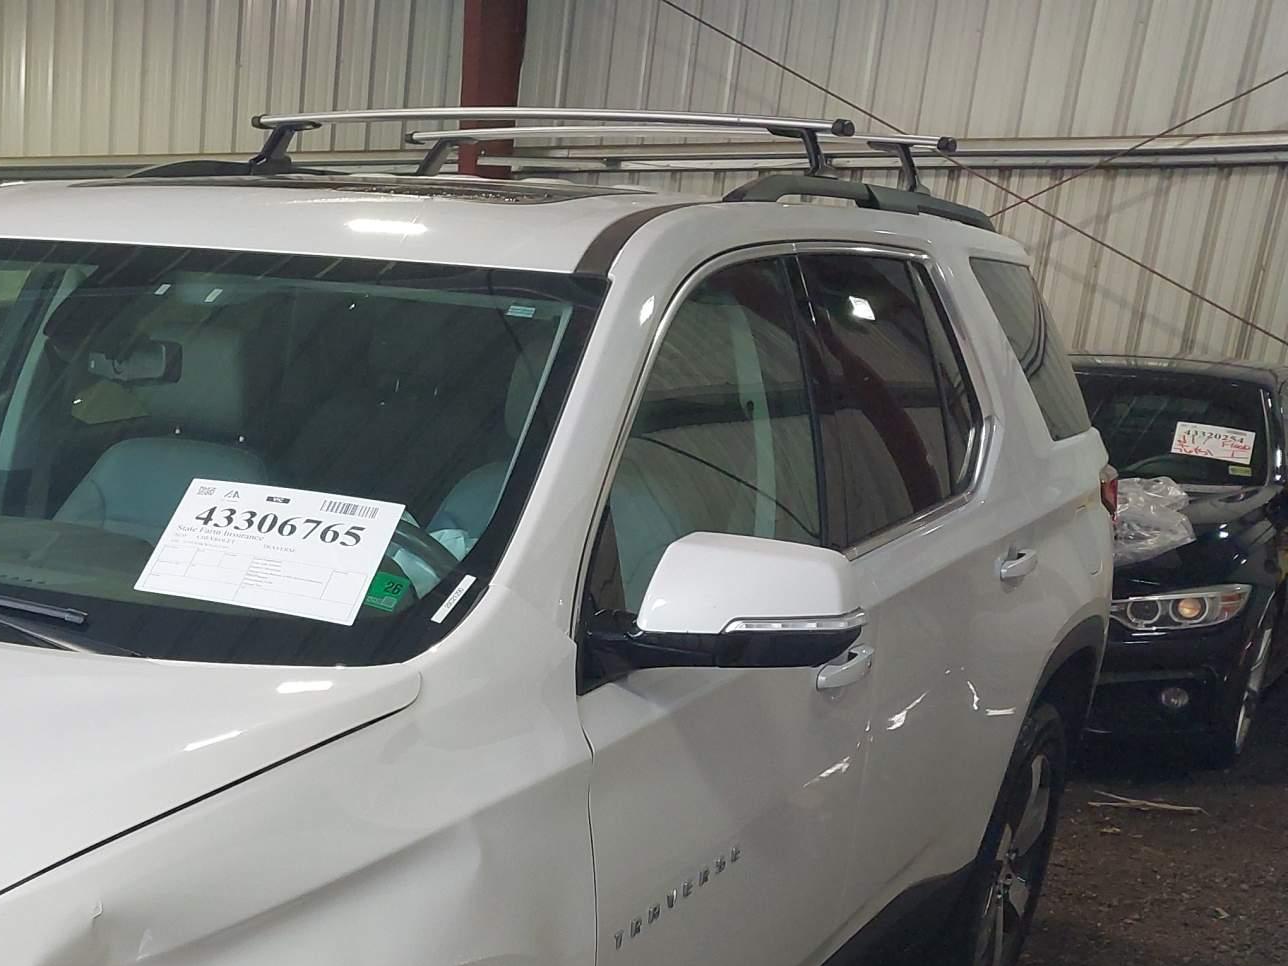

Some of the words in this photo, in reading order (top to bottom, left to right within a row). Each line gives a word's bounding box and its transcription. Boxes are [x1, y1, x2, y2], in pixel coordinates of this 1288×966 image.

[177, 525, 198, 533] State
[223, 529, 265, 542] Insurance
[194, 505, 367, 547] 43306765
[384, 580, 404, 595] 26
[614, 847, 741, 950] TRAVERSE
